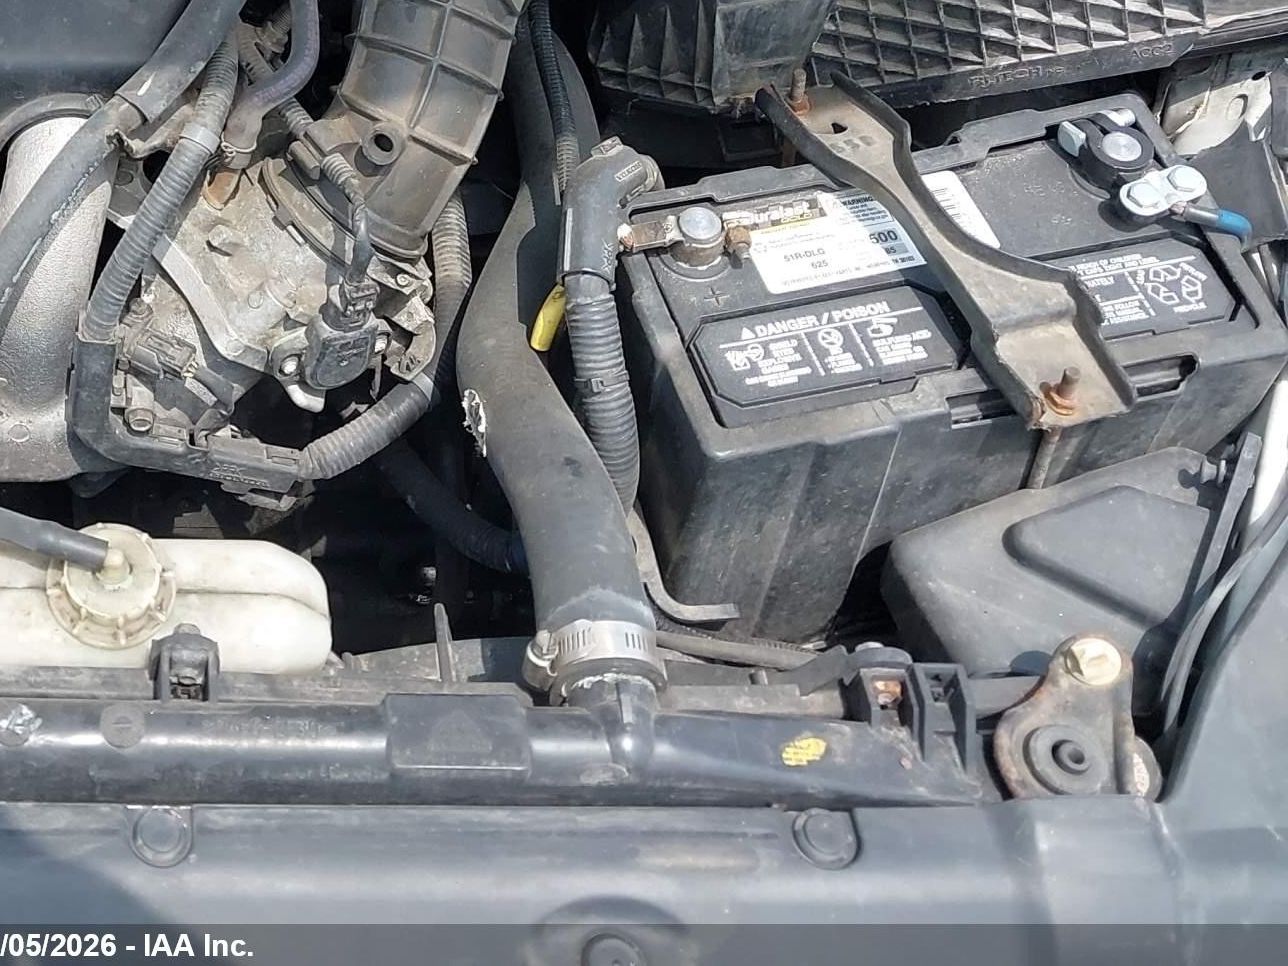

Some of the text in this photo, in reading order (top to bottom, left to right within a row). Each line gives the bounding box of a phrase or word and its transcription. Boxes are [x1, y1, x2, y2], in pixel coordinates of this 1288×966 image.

[869, 230, 899, 244] 500
[755, 315, 819, 335] DANGER
[831, 301, 891, 321] POISON
